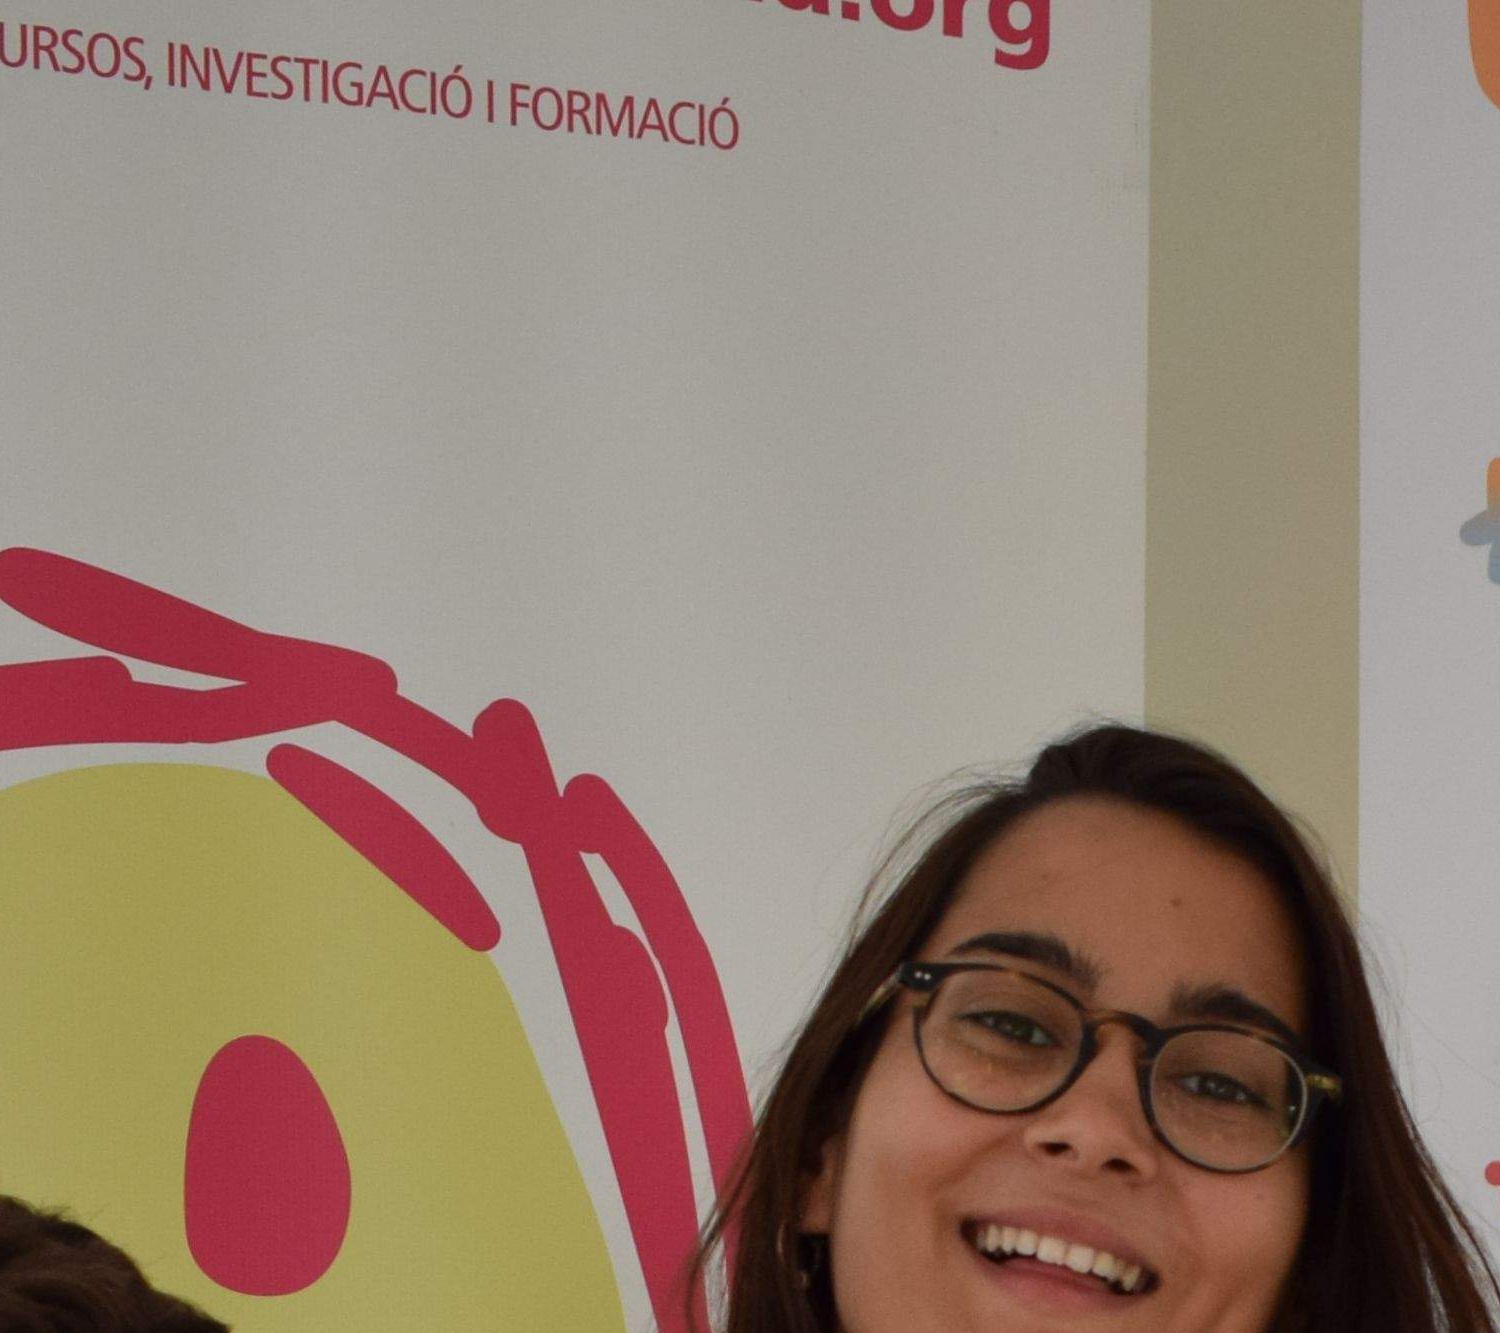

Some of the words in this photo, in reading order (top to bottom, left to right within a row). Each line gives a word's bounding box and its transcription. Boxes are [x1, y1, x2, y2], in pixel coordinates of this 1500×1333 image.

[166, 41, 473, 120] INVESTIGACIÓ
[486, 79, 496, 124] I
[509, 82, 740, 152] FORMACIÓ
